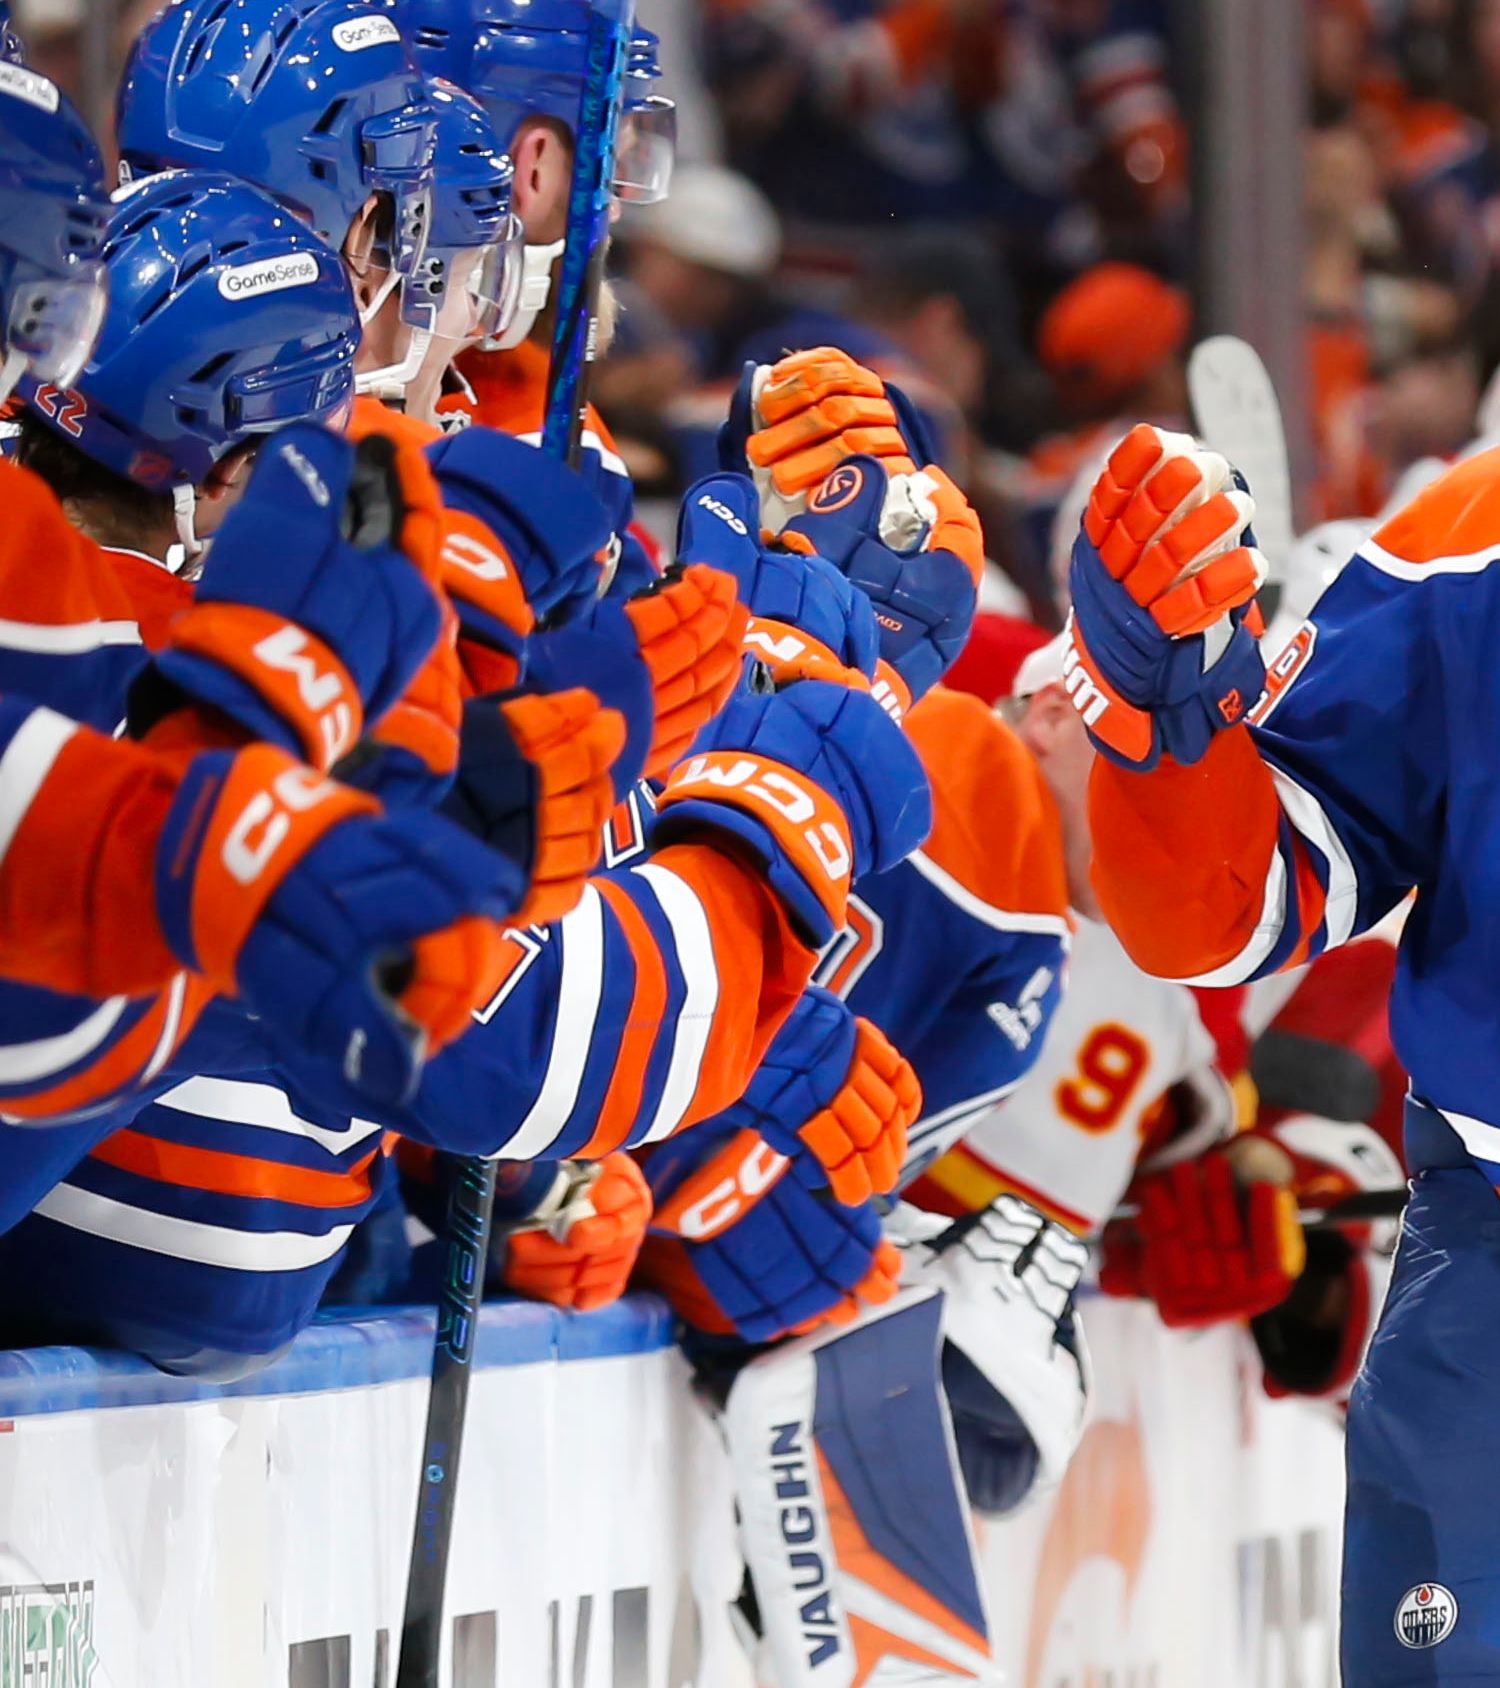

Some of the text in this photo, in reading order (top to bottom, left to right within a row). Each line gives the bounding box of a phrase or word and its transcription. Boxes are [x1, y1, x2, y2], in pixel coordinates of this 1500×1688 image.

[226, 263, 314, 292] GameSense
[35, 383, 88, 438] 22
[698, 494, 748, 535] CCM
[672, 757, 849, 881] CCM
[1054, 1020, 1172, 1140] 9
[771, 1421, 840, 1668] VAUGHN
[1402, 1605, 1447, 1643] OILERS
